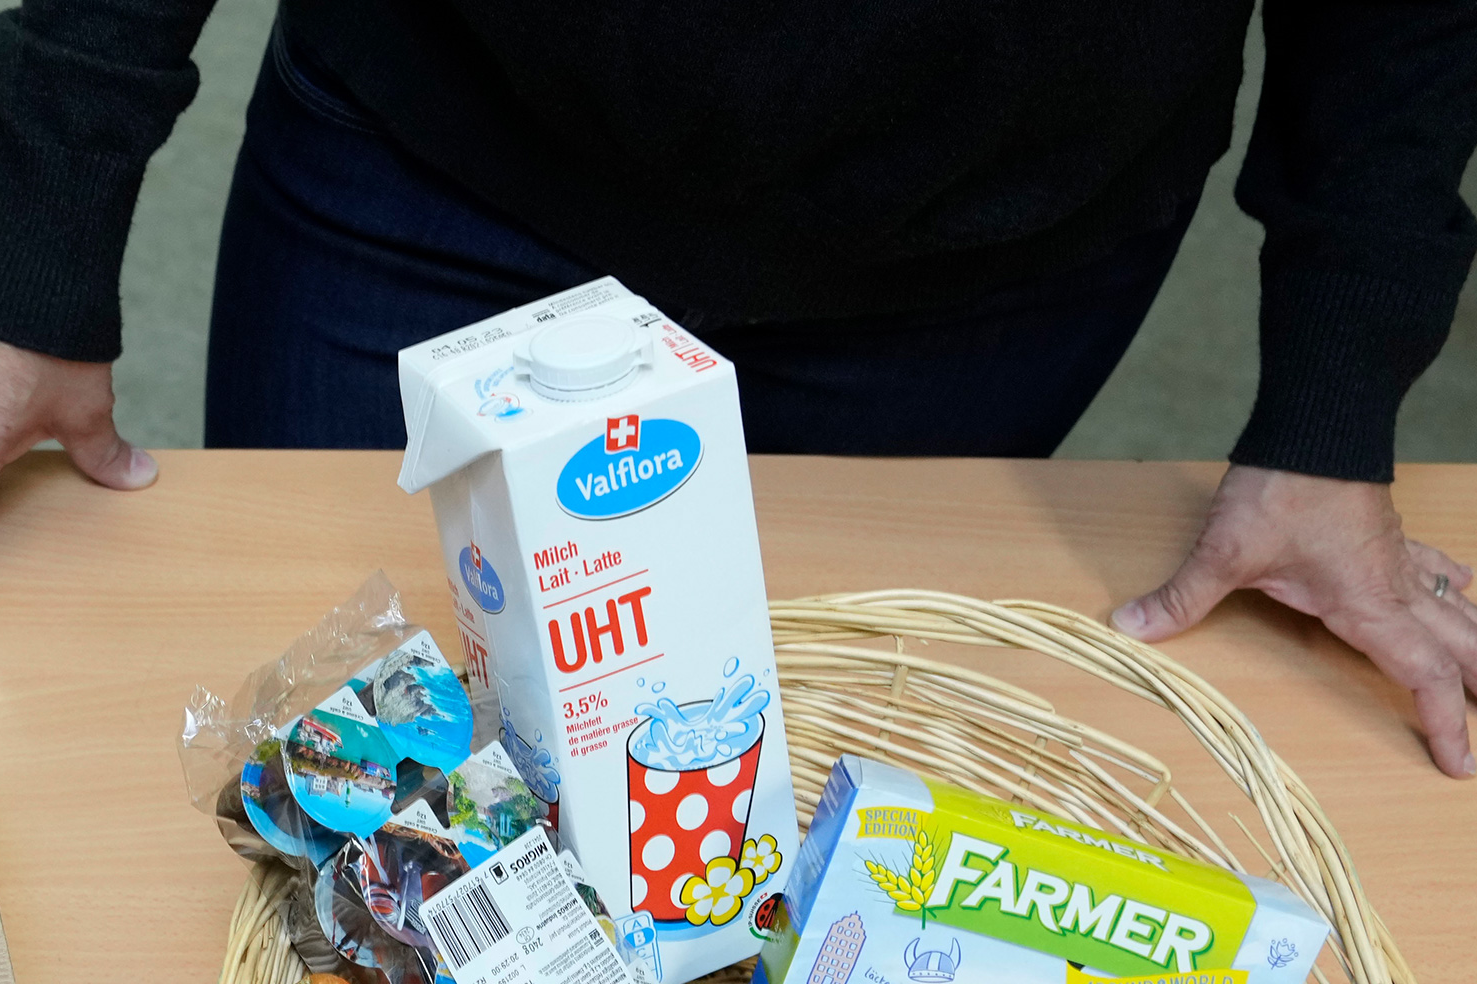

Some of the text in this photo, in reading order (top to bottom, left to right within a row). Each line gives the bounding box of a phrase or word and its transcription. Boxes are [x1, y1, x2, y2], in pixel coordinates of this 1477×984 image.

[535, 311, 556, 324] data
[575, 448, 684, 501] Valflora
[533, 540, 579, 570] Milch
[538, 549, 623, 593] Lait Latte
[547, 585, 653, 675] UHT
[562, 690, 609, 719] 3,5%
[566, 715, 603, 735] Milchfett
[568, 715, 639, 747] de matière grasse
[570, 739, 609, 757] di grasso
[863, 822, 918, 839] EDITION
[864, 808, 920, 826] SPECIAL
[1008, 808, 1170, 872] FARMER
[507, 840, 548, 875] MIGROS
[554, 896, 580, 917] MIGROS
[924, 830, 1215, 974] FARMER
[488, 951, 520, 977] 20:29:00
